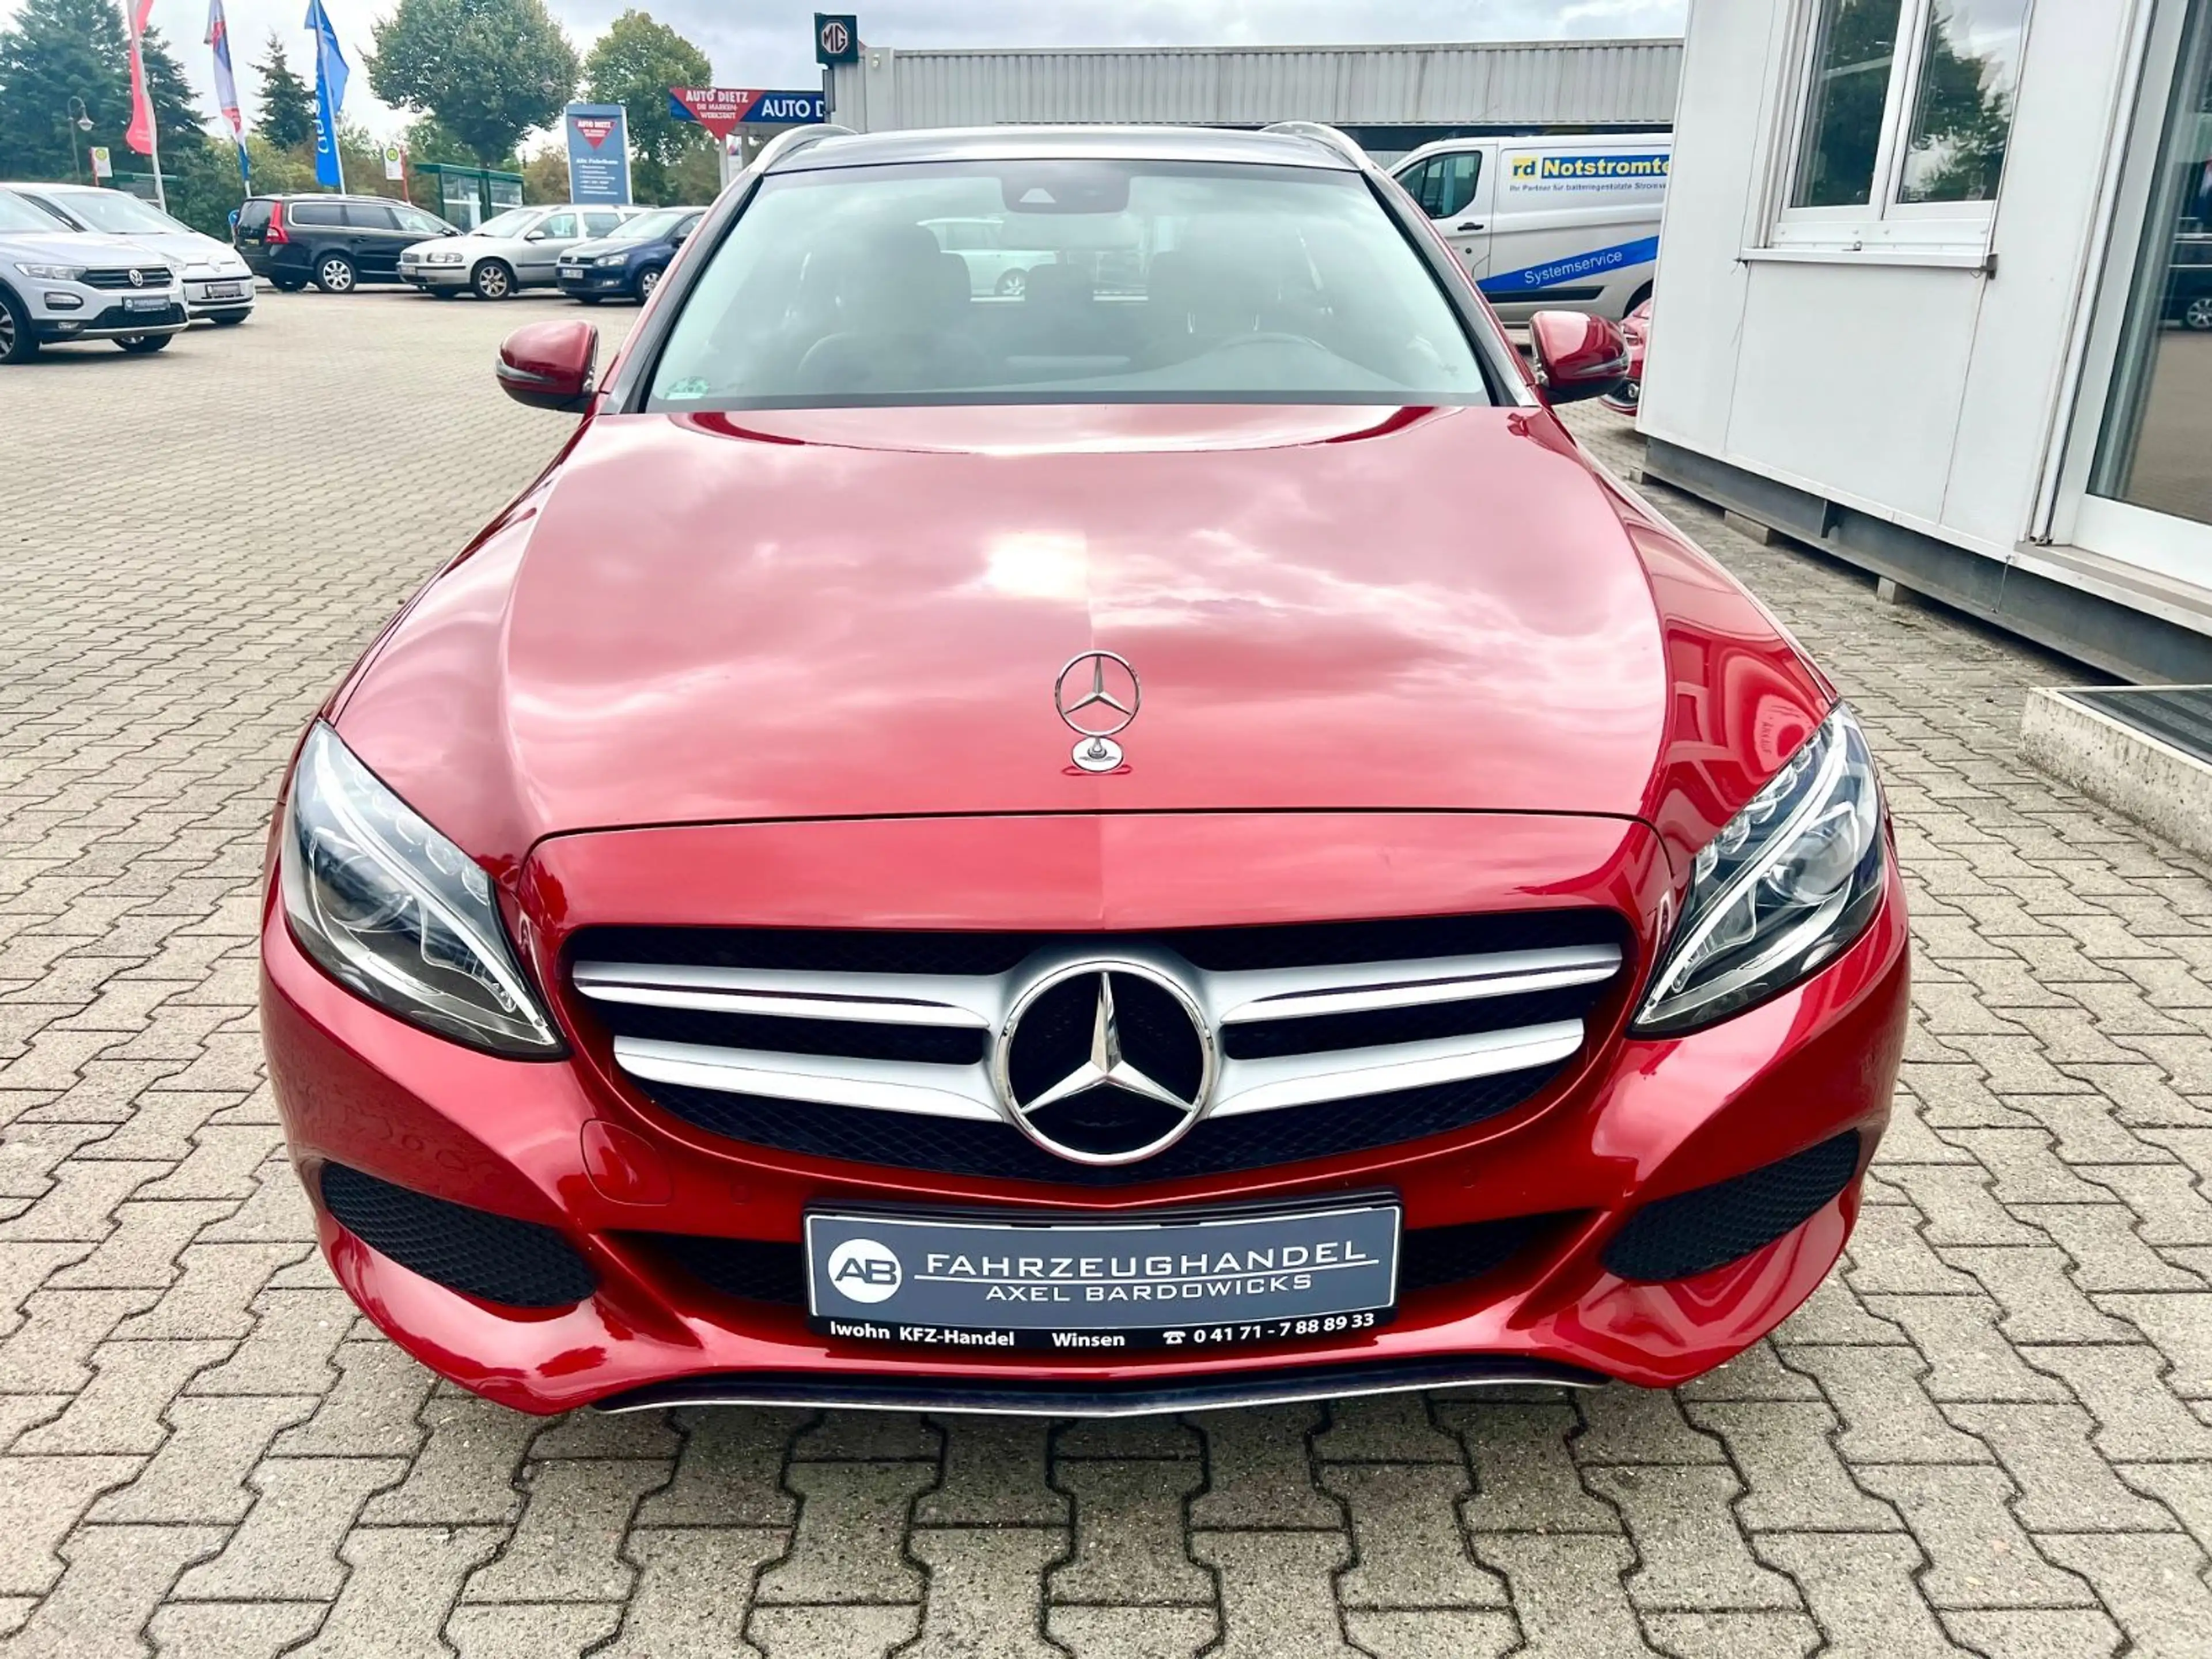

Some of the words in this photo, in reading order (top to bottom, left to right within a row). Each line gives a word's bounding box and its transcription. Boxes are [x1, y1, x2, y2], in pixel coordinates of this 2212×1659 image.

[823, 25, 846, 51] MG
[686, 90, 714, 102] AUTO
[718, 91, 748, 103] DIETZ
[762, 100, 810, 117] AUTO
[1513, 161, 1536, 176] rd
[1525, 251, 1623, 285] Systemservice
[835, 1257, 897, 1286] AB
[927, 1240, 1366, 1278] FAHRZEUGHANDEL
[986, 1285, 1070, 1301] AXEL
[1086, 1274, 1312, 1301] BARDOWICKS
[900, 1327, 1014, 1346] KFZ-Handel
[1052, 1332, 1125, 1347] Winsen
